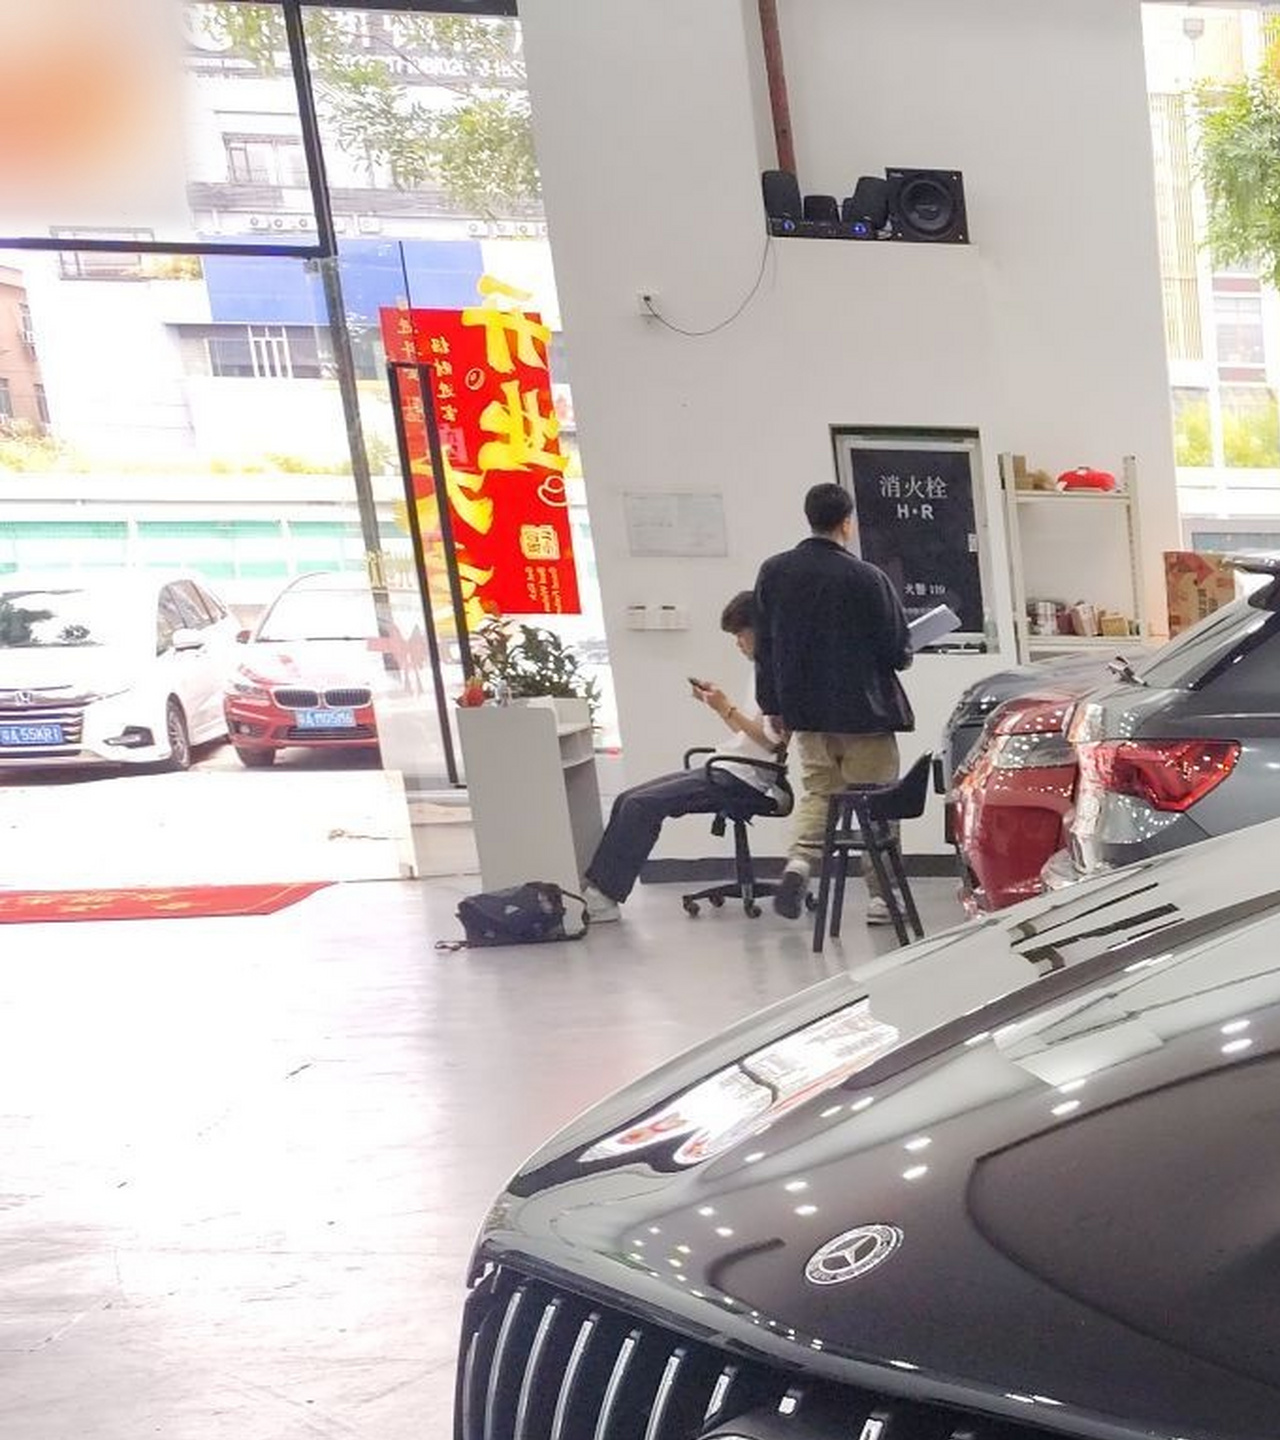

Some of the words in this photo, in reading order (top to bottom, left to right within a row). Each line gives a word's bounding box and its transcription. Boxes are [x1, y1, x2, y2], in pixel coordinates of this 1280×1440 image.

[878, 474, 950, 499] 消火栓
[905, 582, 926, 596] 火警
[929, 584, 946, 595] 119
